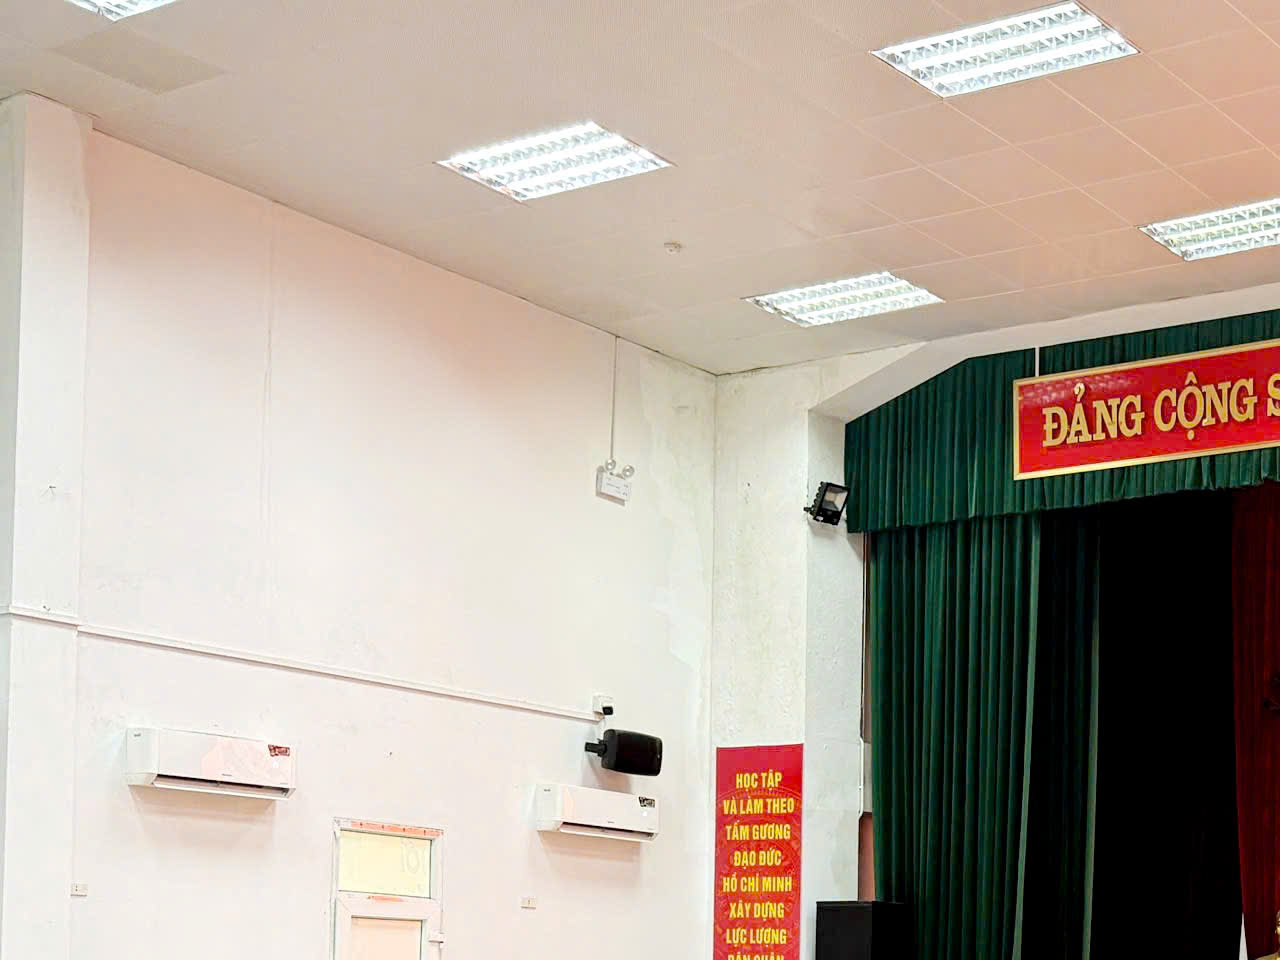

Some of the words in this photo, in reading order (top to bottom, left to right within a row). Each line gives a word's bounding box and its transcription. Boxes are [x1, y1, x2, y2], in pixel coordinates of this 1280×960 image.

[1042, 382, 1145, 448] ĐẢNG
[1153, 371, 1257, 440] CỘNG
[736, 773, 758, 791] HỌC
[761, 769, 782, 791] TẬP
[723, 797, 738, 815] VÀ
[740, 796, 763, 814] LÀM
[766, 797, 795, 814] THEO
[726, 820, 750, 841] TẤM
[752, 824, 791, 840] GƯƠNG
[733, 851, 756, 870] ĐẠO
[759, 848, 782, 866] ĐỨC
[722, 872, 738, 892] HỒ
[740, 873, 759, 892] CHÍ
[762, 876, 792, 892] MINH
[729, 900, 751, 919] XÂY
[754, 903, 785, 921] DỰNG
[726, 928, 747, 947] LỰC
[750, 928, 787, 948] LƯỢNG
